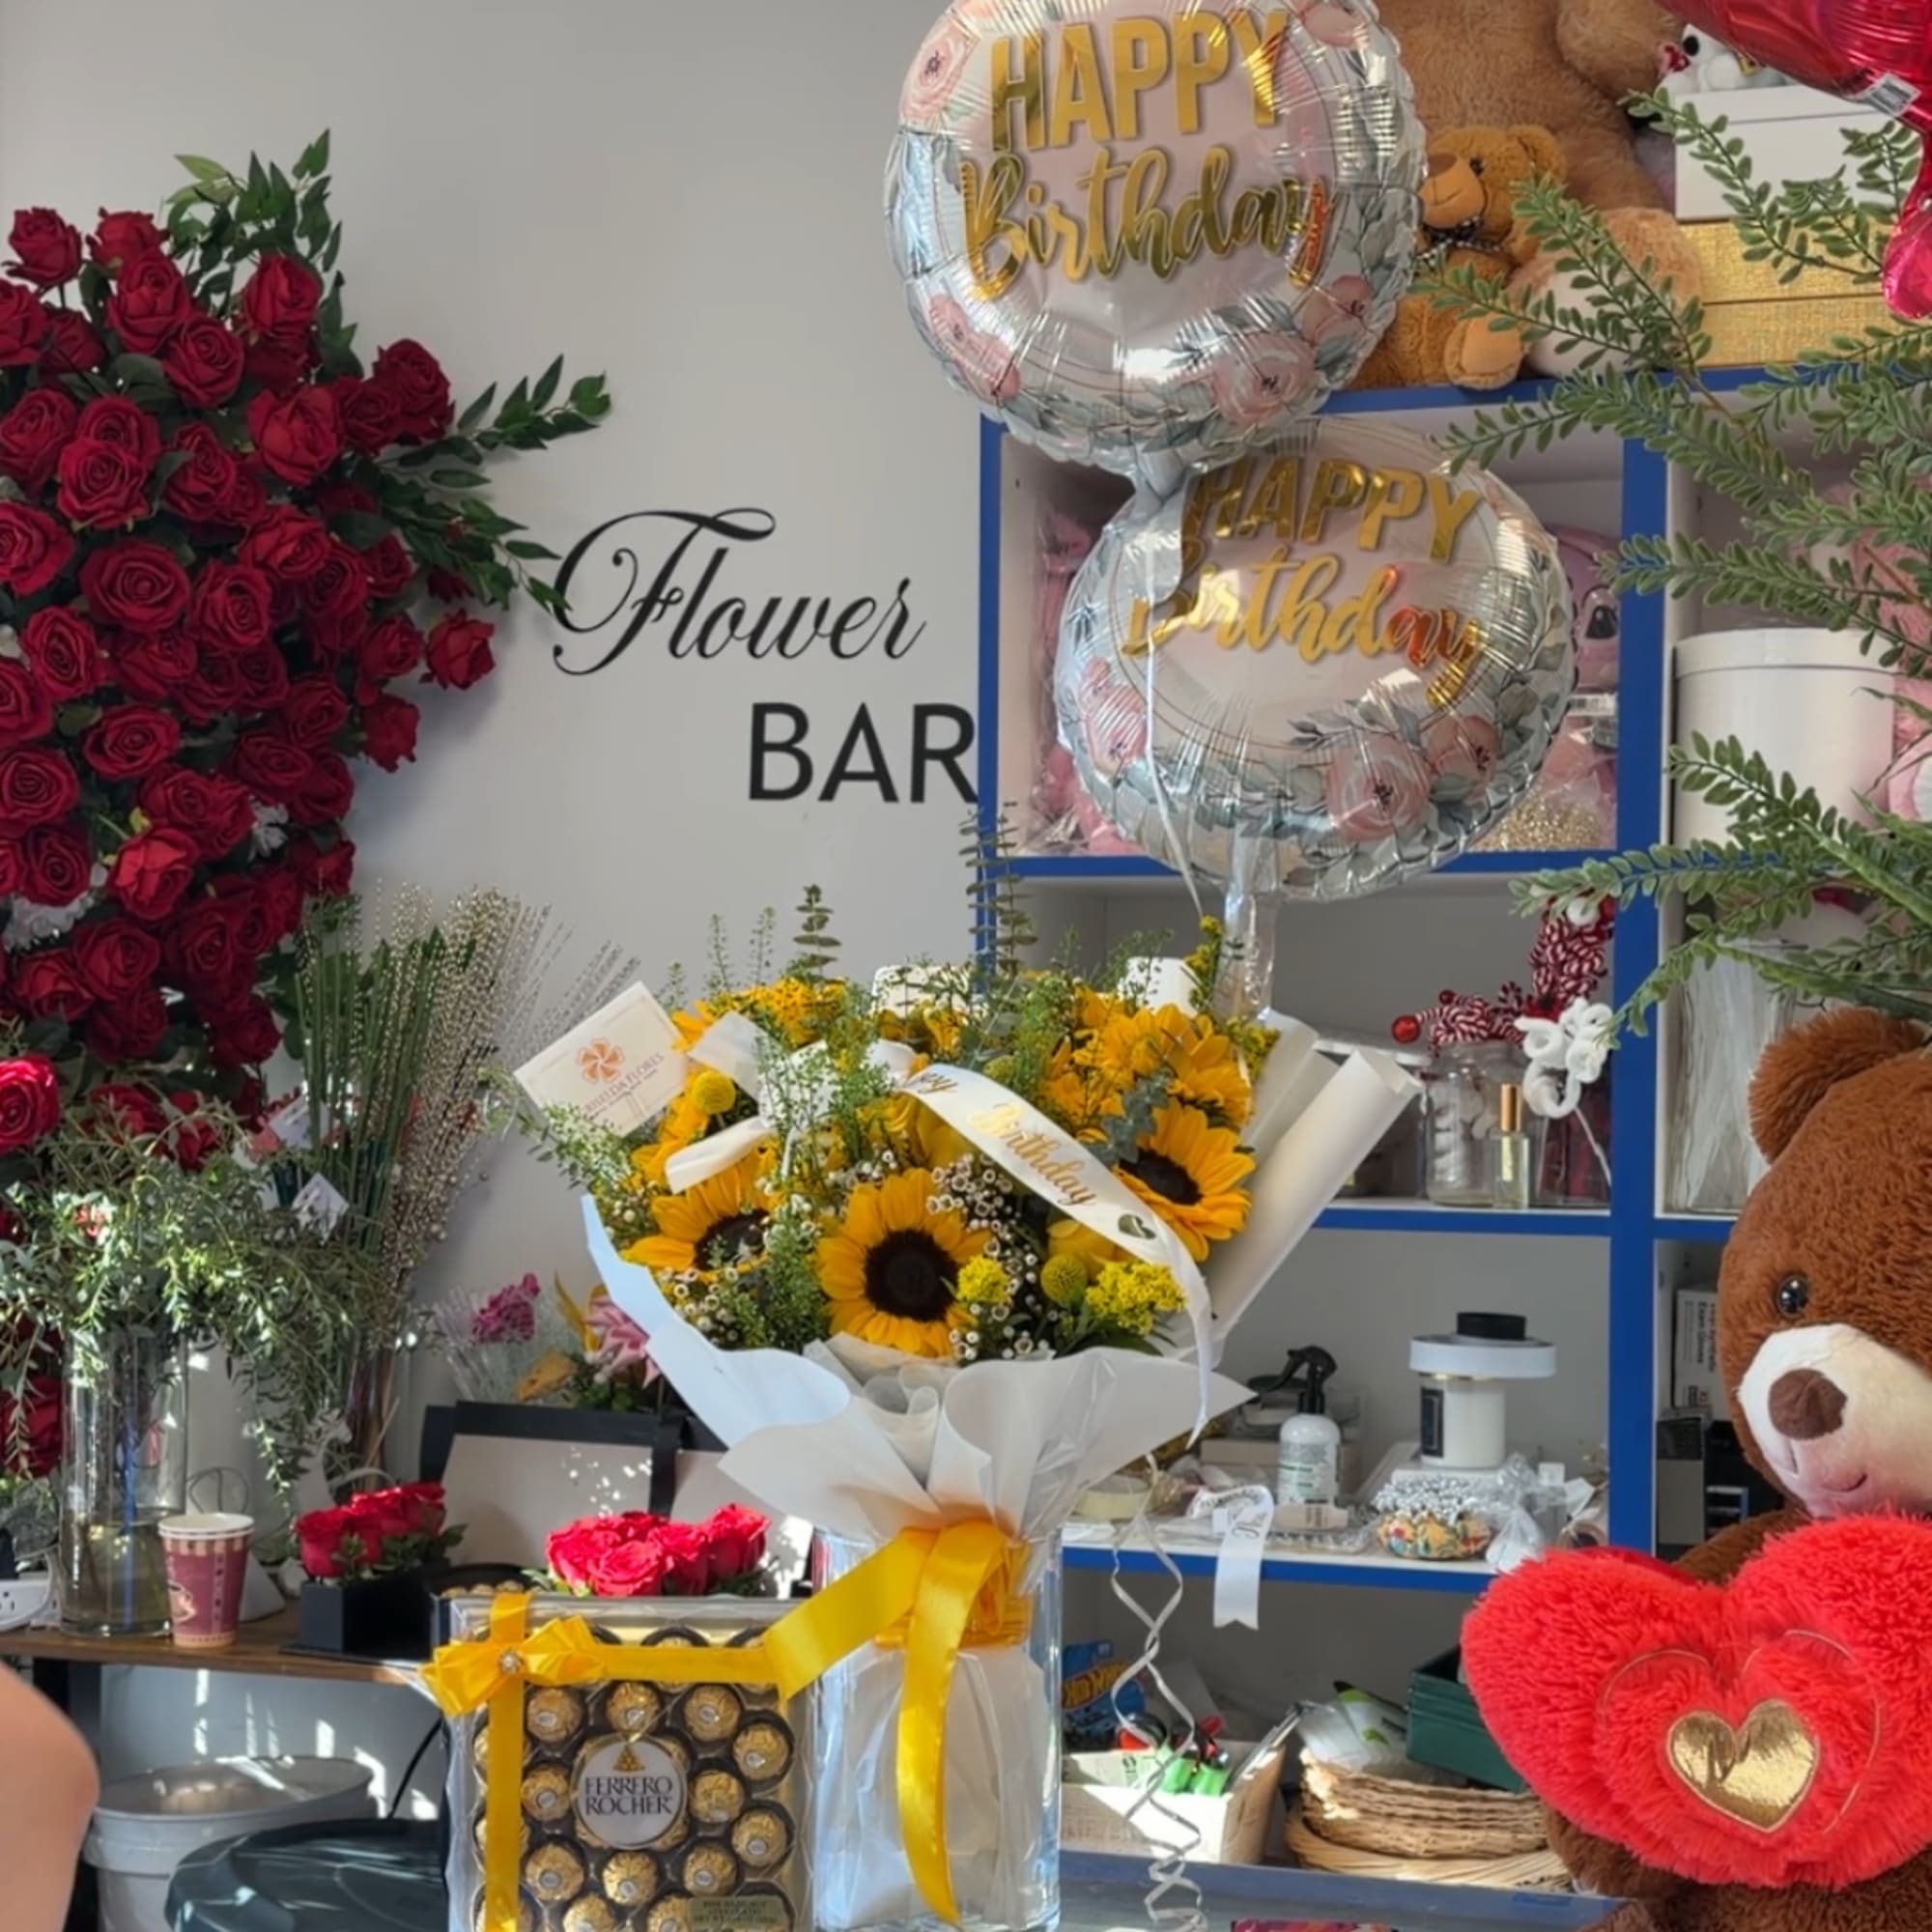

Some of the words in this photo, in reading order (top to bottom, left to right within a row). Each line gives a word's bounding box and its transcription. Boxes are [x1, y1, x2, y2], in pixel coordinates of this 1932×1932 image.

[990, 9, 1289, 152] HAPPY
[959, 145, 1326, 301] Birthday
[1179, 456, 1482, 566] HAPPY
[554, 508, 926, 675] Flower
[749, 702, 979, 804] BAR
[969, 1102, 1096, 1207] Birthday
[584, 1776, 674, 1795] FERRERO
[584, 1795, 674, 1815] ROCHER
